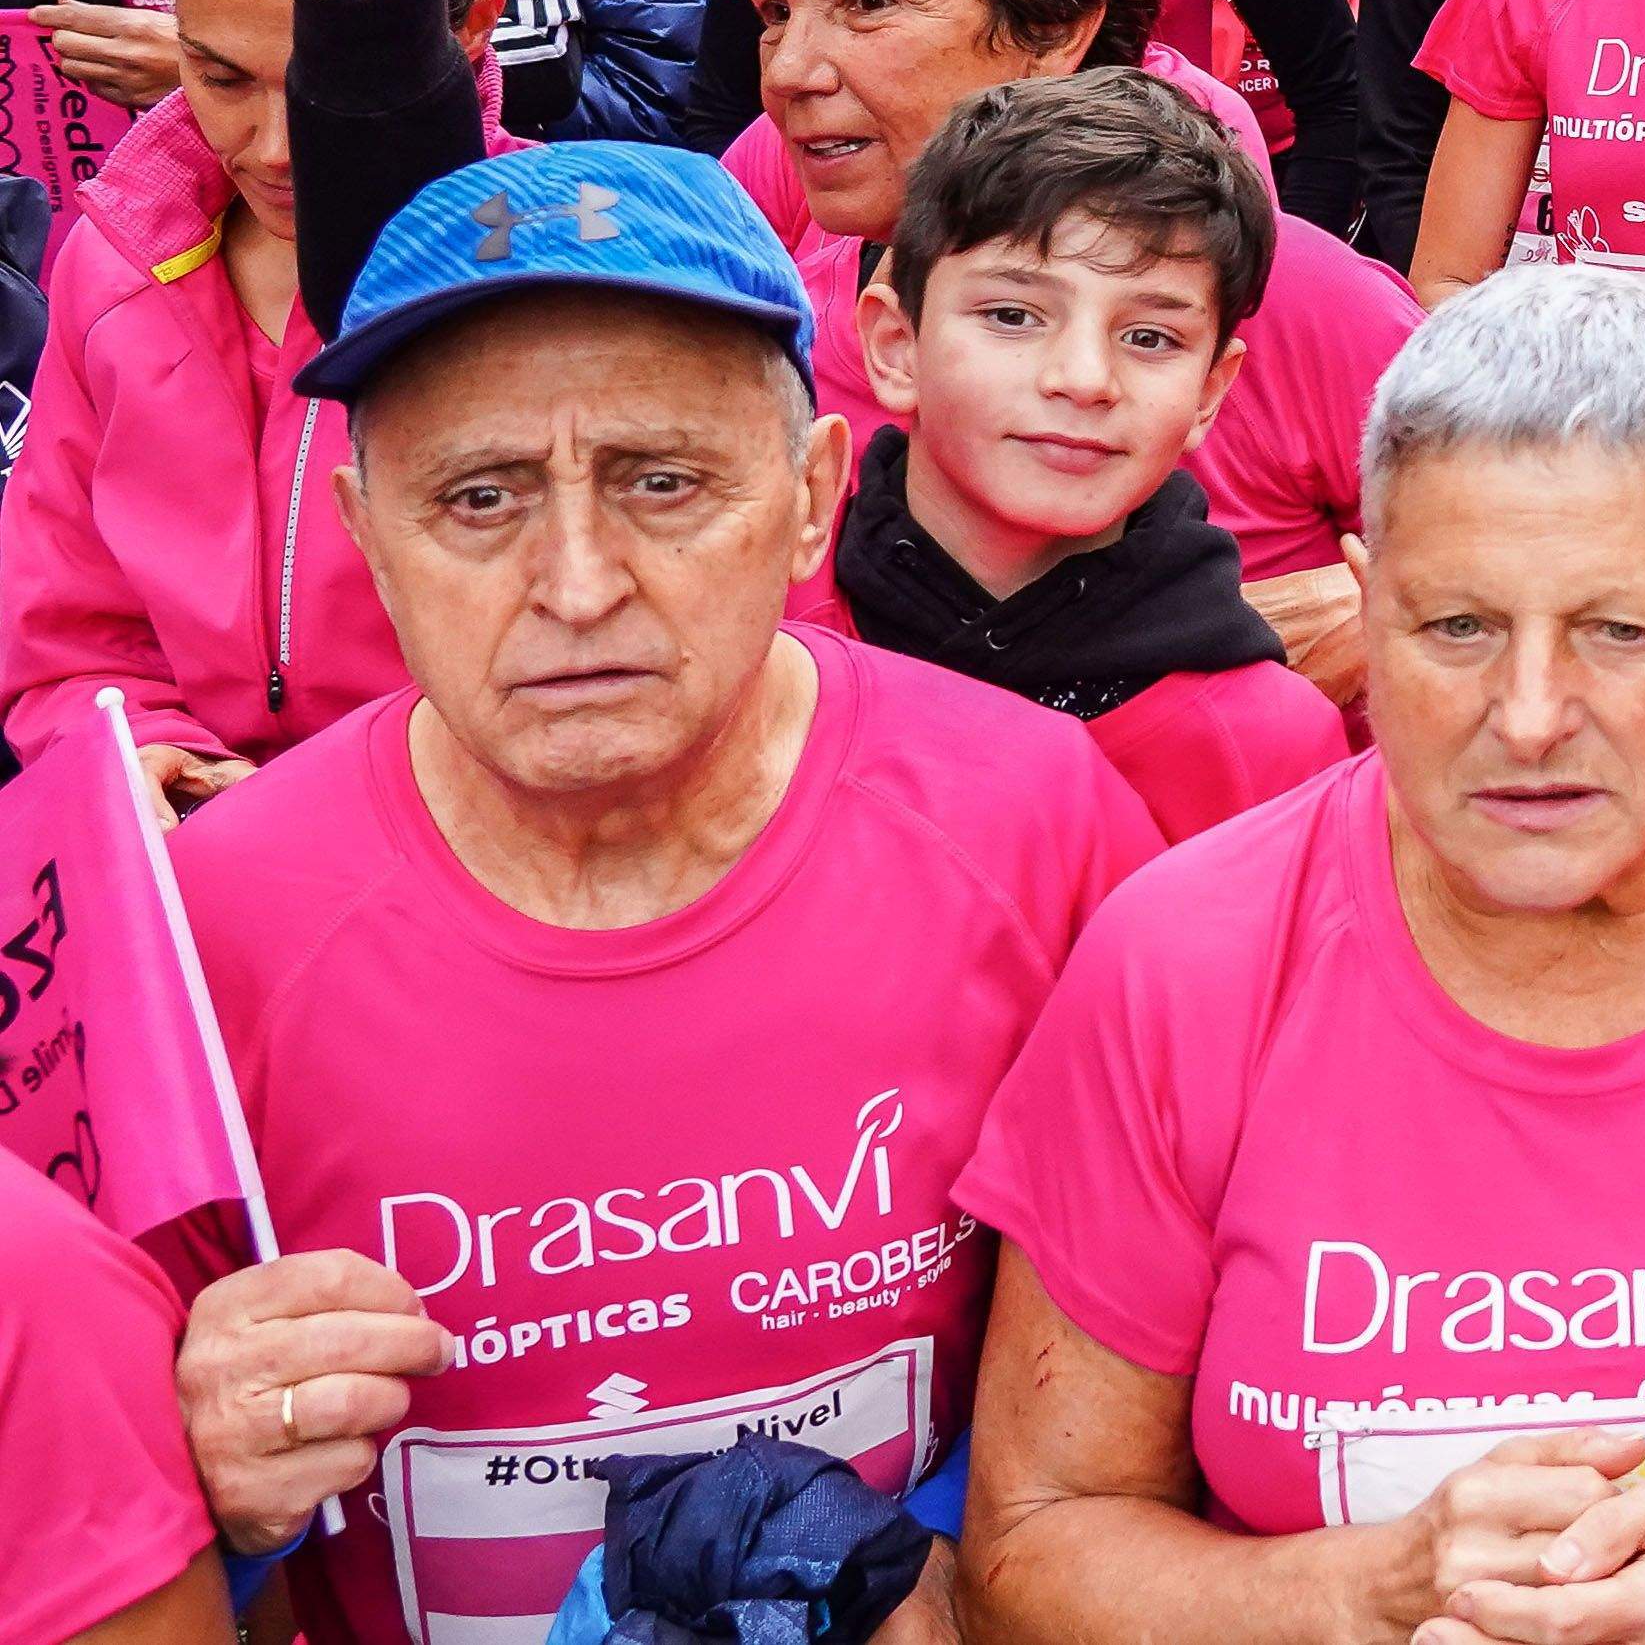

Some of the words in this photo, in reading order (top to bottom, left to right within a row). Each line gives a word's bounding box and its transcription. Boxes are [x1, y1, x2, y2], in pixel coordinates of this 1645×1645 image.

[380, 1087, 903, 1298] Drasanvi
[730, 1209, 977, 1315] CAROBELS
[761, 1308, 806, 1332] hair
[827, 1286, 902, 1321] beauty
